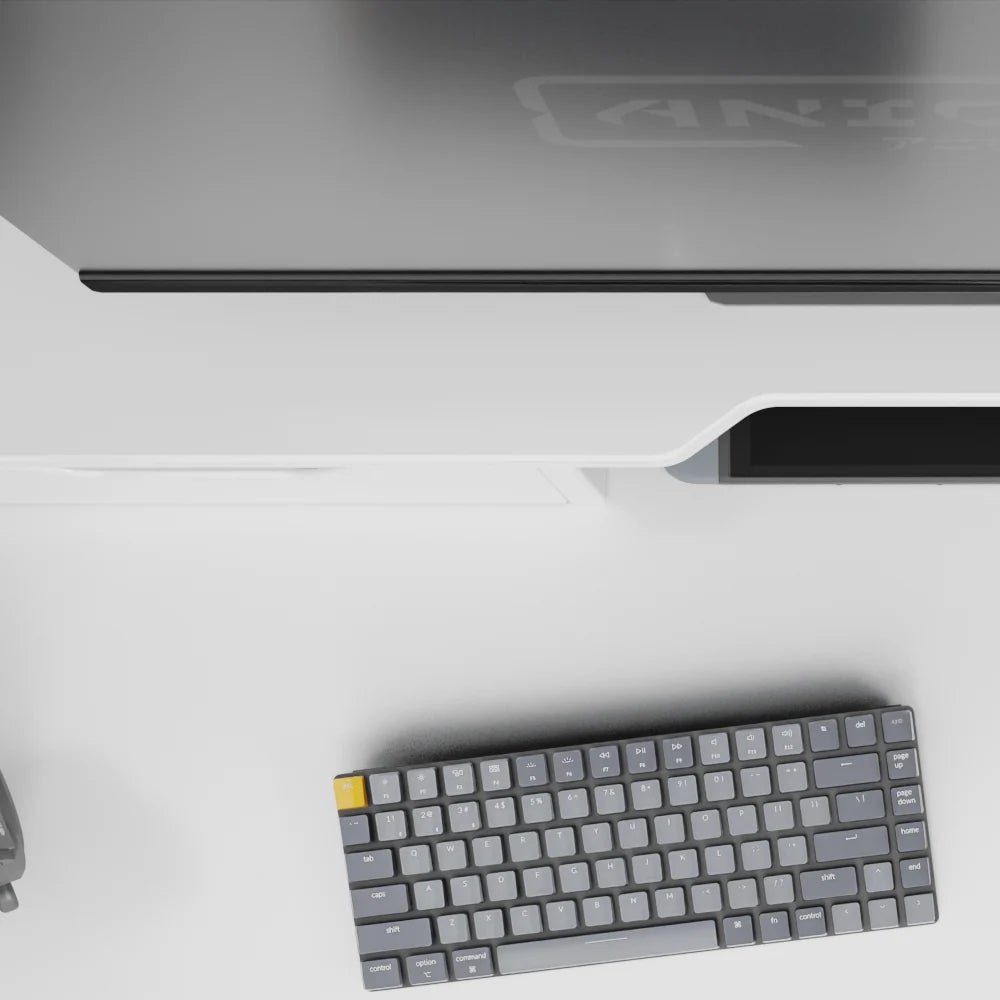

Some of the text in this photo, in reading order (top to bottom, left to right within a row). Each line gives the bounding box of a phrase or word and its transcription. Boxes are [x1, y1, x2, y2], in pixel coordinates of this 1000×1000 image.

[855, 720, 866, 729] del
[893, 752, 909, 761] page
[894, 762, 904, 770] up
[896, 789, 913, 799] page
[898, 797, 916, 806] down
[901, 826, 920, 836] home
[363, 854, 374, 863] tab
[908, 863, 921, 872] end
[821, 872, 836, 882] shift
[371, 889, 386, 899] caps
[799, 912, 822, 922] control
[385, 925, 401, 934] shift
[455, 952, 487, 963] command
[369, 963, 392, 973] control
[415, 958, 437, 969] option
